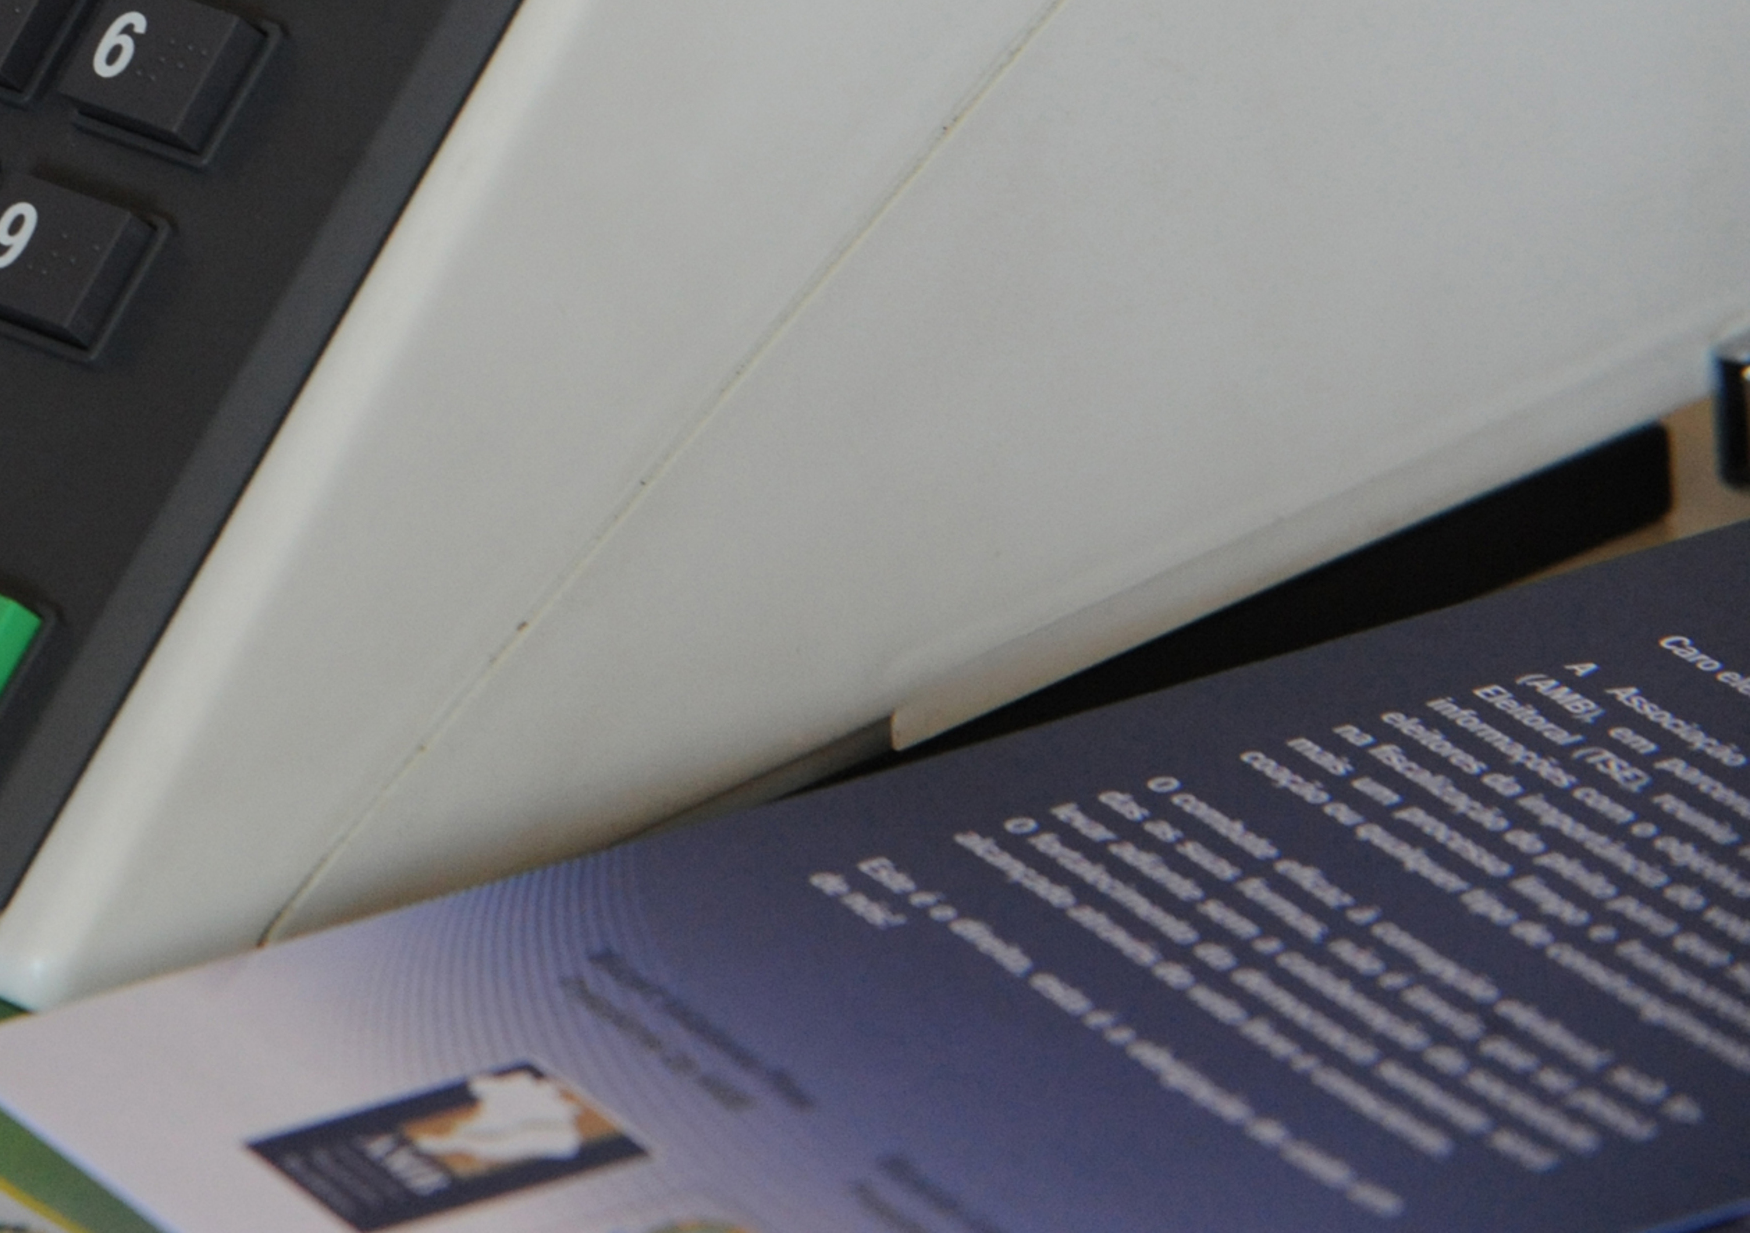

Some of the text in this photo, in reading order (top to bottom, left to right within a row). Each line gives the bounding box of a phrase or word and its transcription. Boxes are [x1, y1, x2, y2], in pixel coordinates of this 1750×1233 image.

[91, 11, 147, 78] 6
[1659, 634, 1722, 672] Caro
[1472, 684, 1586, 746] Eleitoral
